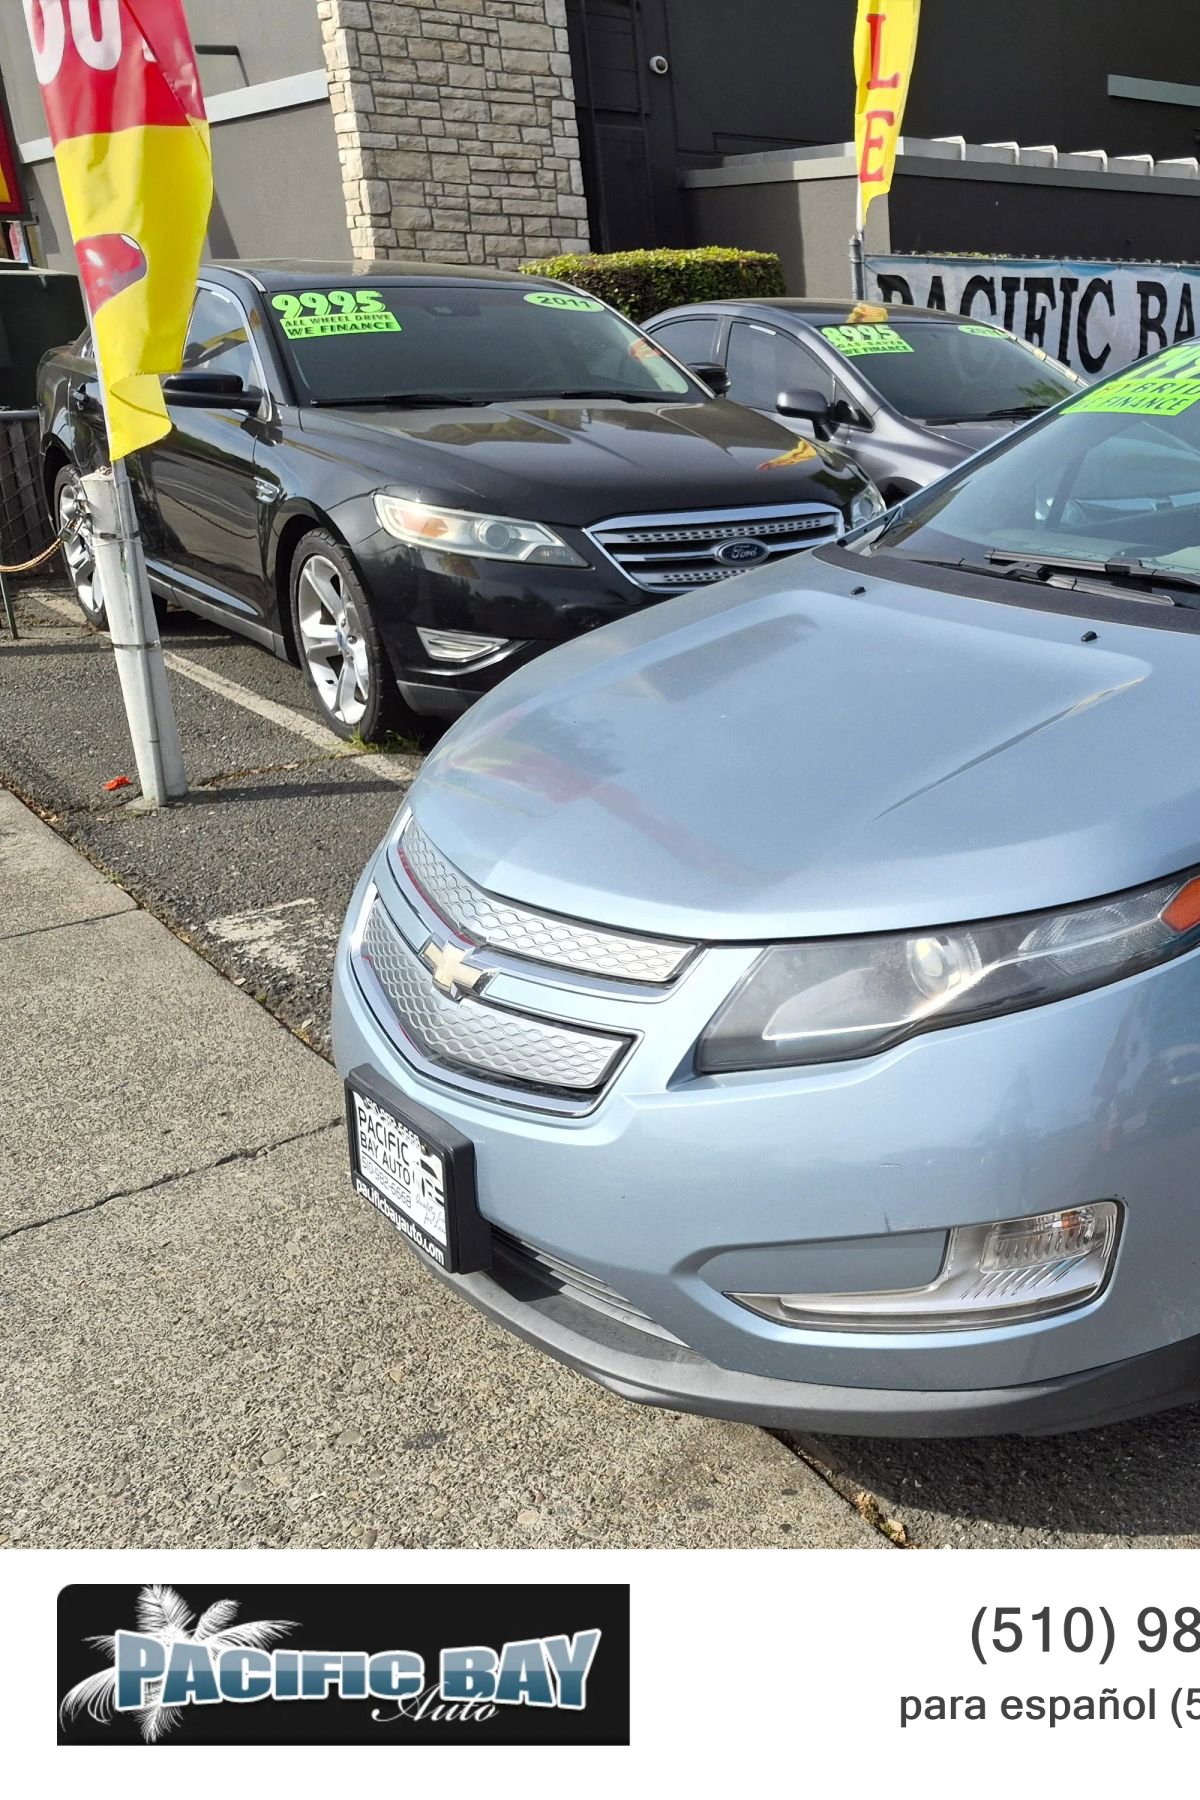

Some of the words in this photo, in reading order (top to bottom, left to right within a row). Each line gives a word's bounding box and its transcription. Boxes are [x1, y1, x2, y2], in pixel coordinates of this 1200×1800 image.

[272, 290, 386, 319] 9995
[537, 295, 592, 308] 2011
[285, 319, 307, 327] ALL
[310, 316, 350, 325] WHEEL
[355, 314, 393, 322] DRIVE
[287, 326, 314, 336] WE
[320, 322, 397, 334] FINANCE
[863, 345, 910, 354] FINANCE
[1104, 396, 1191, 410] FINANCE
[731, 544, 758, 559] Ford
[358, 1106, 410, 1167] PACIFIC
[360, 1131, 379, 1159] BAY
[382, 1150, 411, 1186] AUTO
[355, 1178, 445, 1266] pacificbayauto.com
